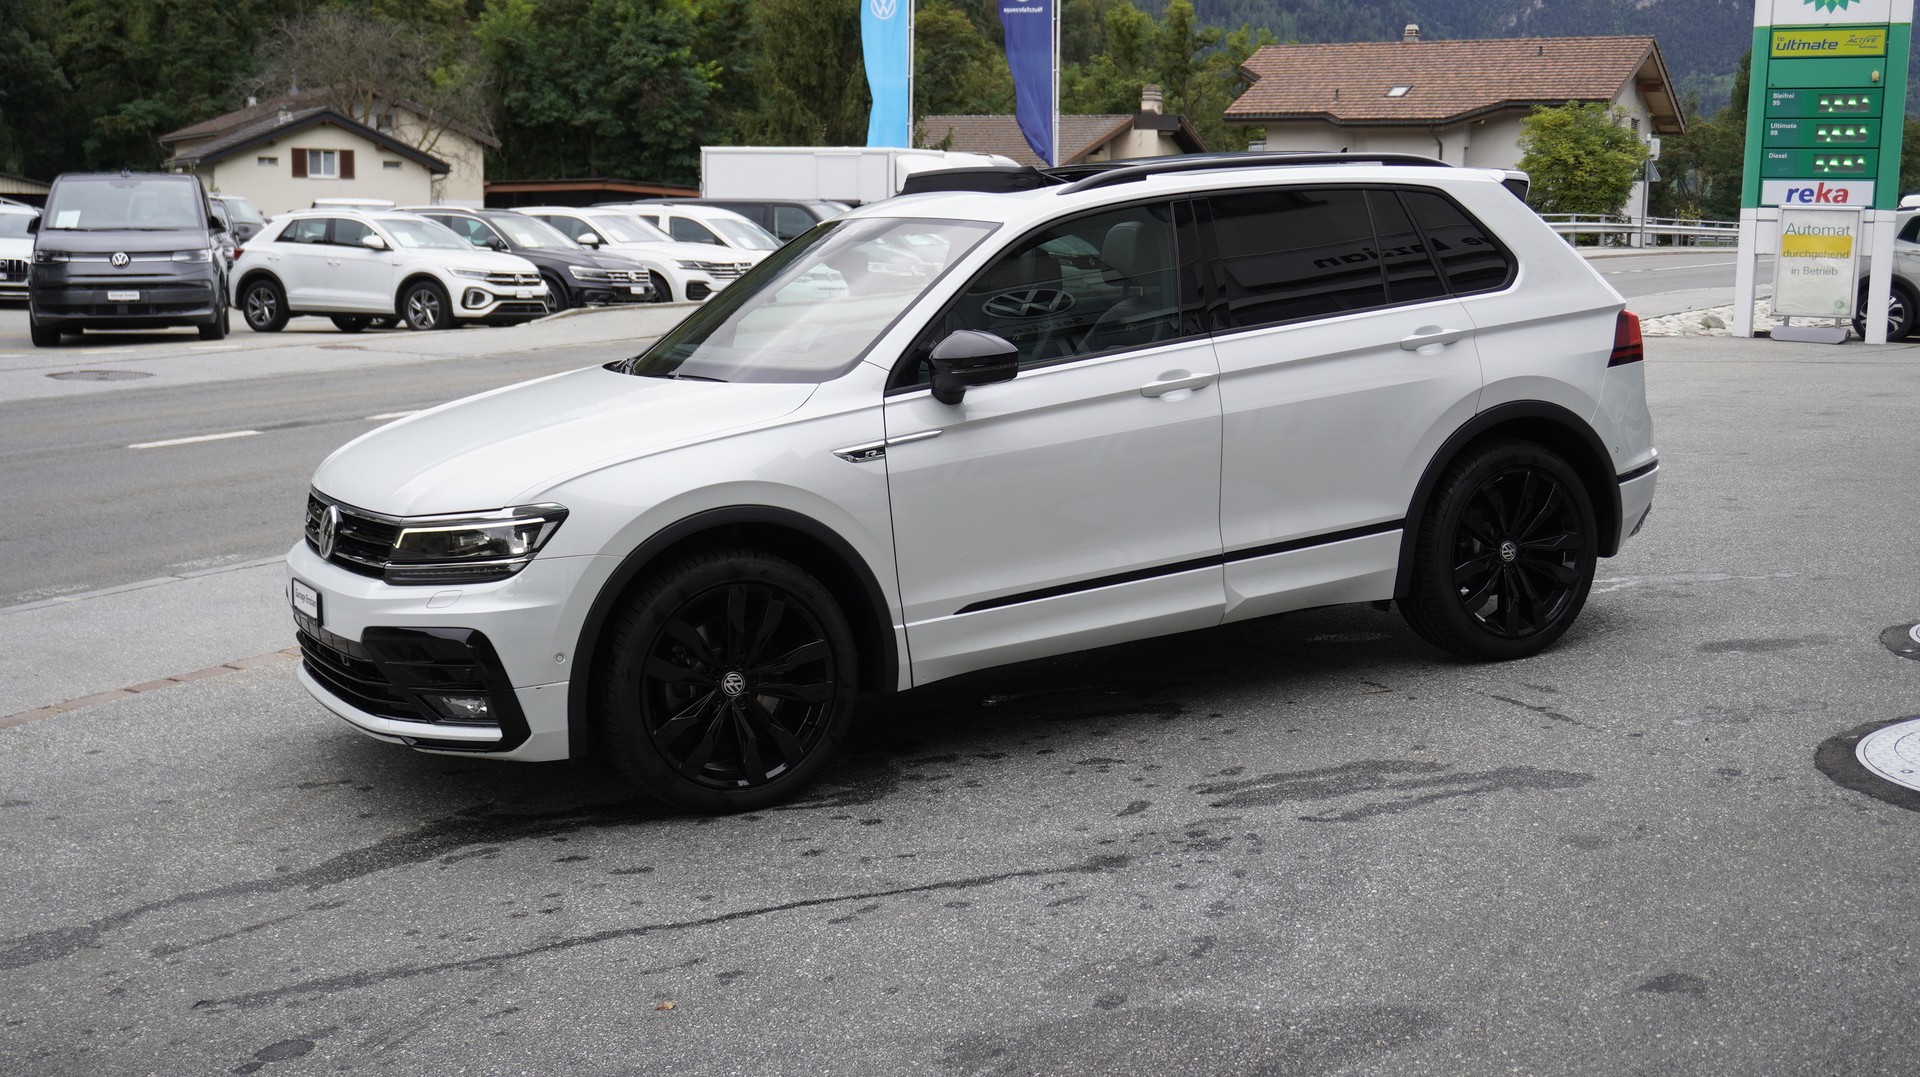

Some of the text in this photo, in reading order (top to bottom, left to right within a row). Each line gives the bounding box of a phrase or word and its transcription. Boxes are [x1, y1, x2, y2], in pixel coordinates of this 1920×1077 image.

[1776, 38, 1838, 51] ultimate
[1785, 182, 1849, 204] reka
[1785, 222, 1851, 236] Automat
[1791, 266, 1838, 276] in Betrieb
